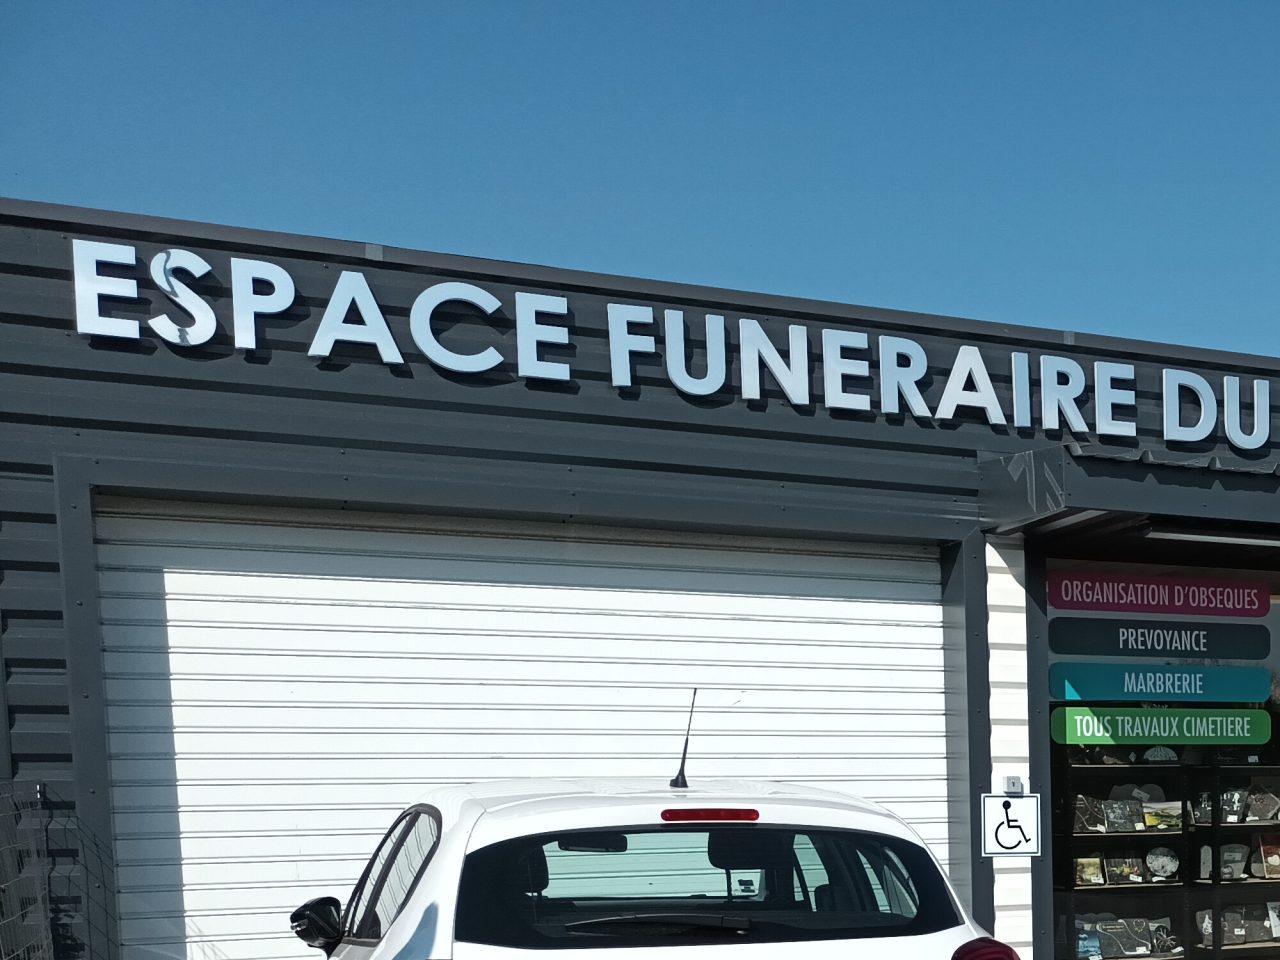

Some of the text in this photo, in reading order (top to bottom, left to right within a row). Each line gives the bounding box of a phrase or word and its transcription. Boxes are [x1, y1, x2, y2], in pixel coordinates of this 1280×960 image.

[72, 239, 571, 381] ESPACE
[607, 302, 1137, 437] FUNERAIRE
[1162, 368, 1270, 450] DU
[1061, 580, 1259, 610] ORGANISATION D'OBSEQUES
[1119, 628, 1208, 651] PREVOYANCE
[1124, 672, 1204, 694] MARBRERIE
[1074, 715, 1251, 738] TOUS TRAVAUX CIMETIERE
